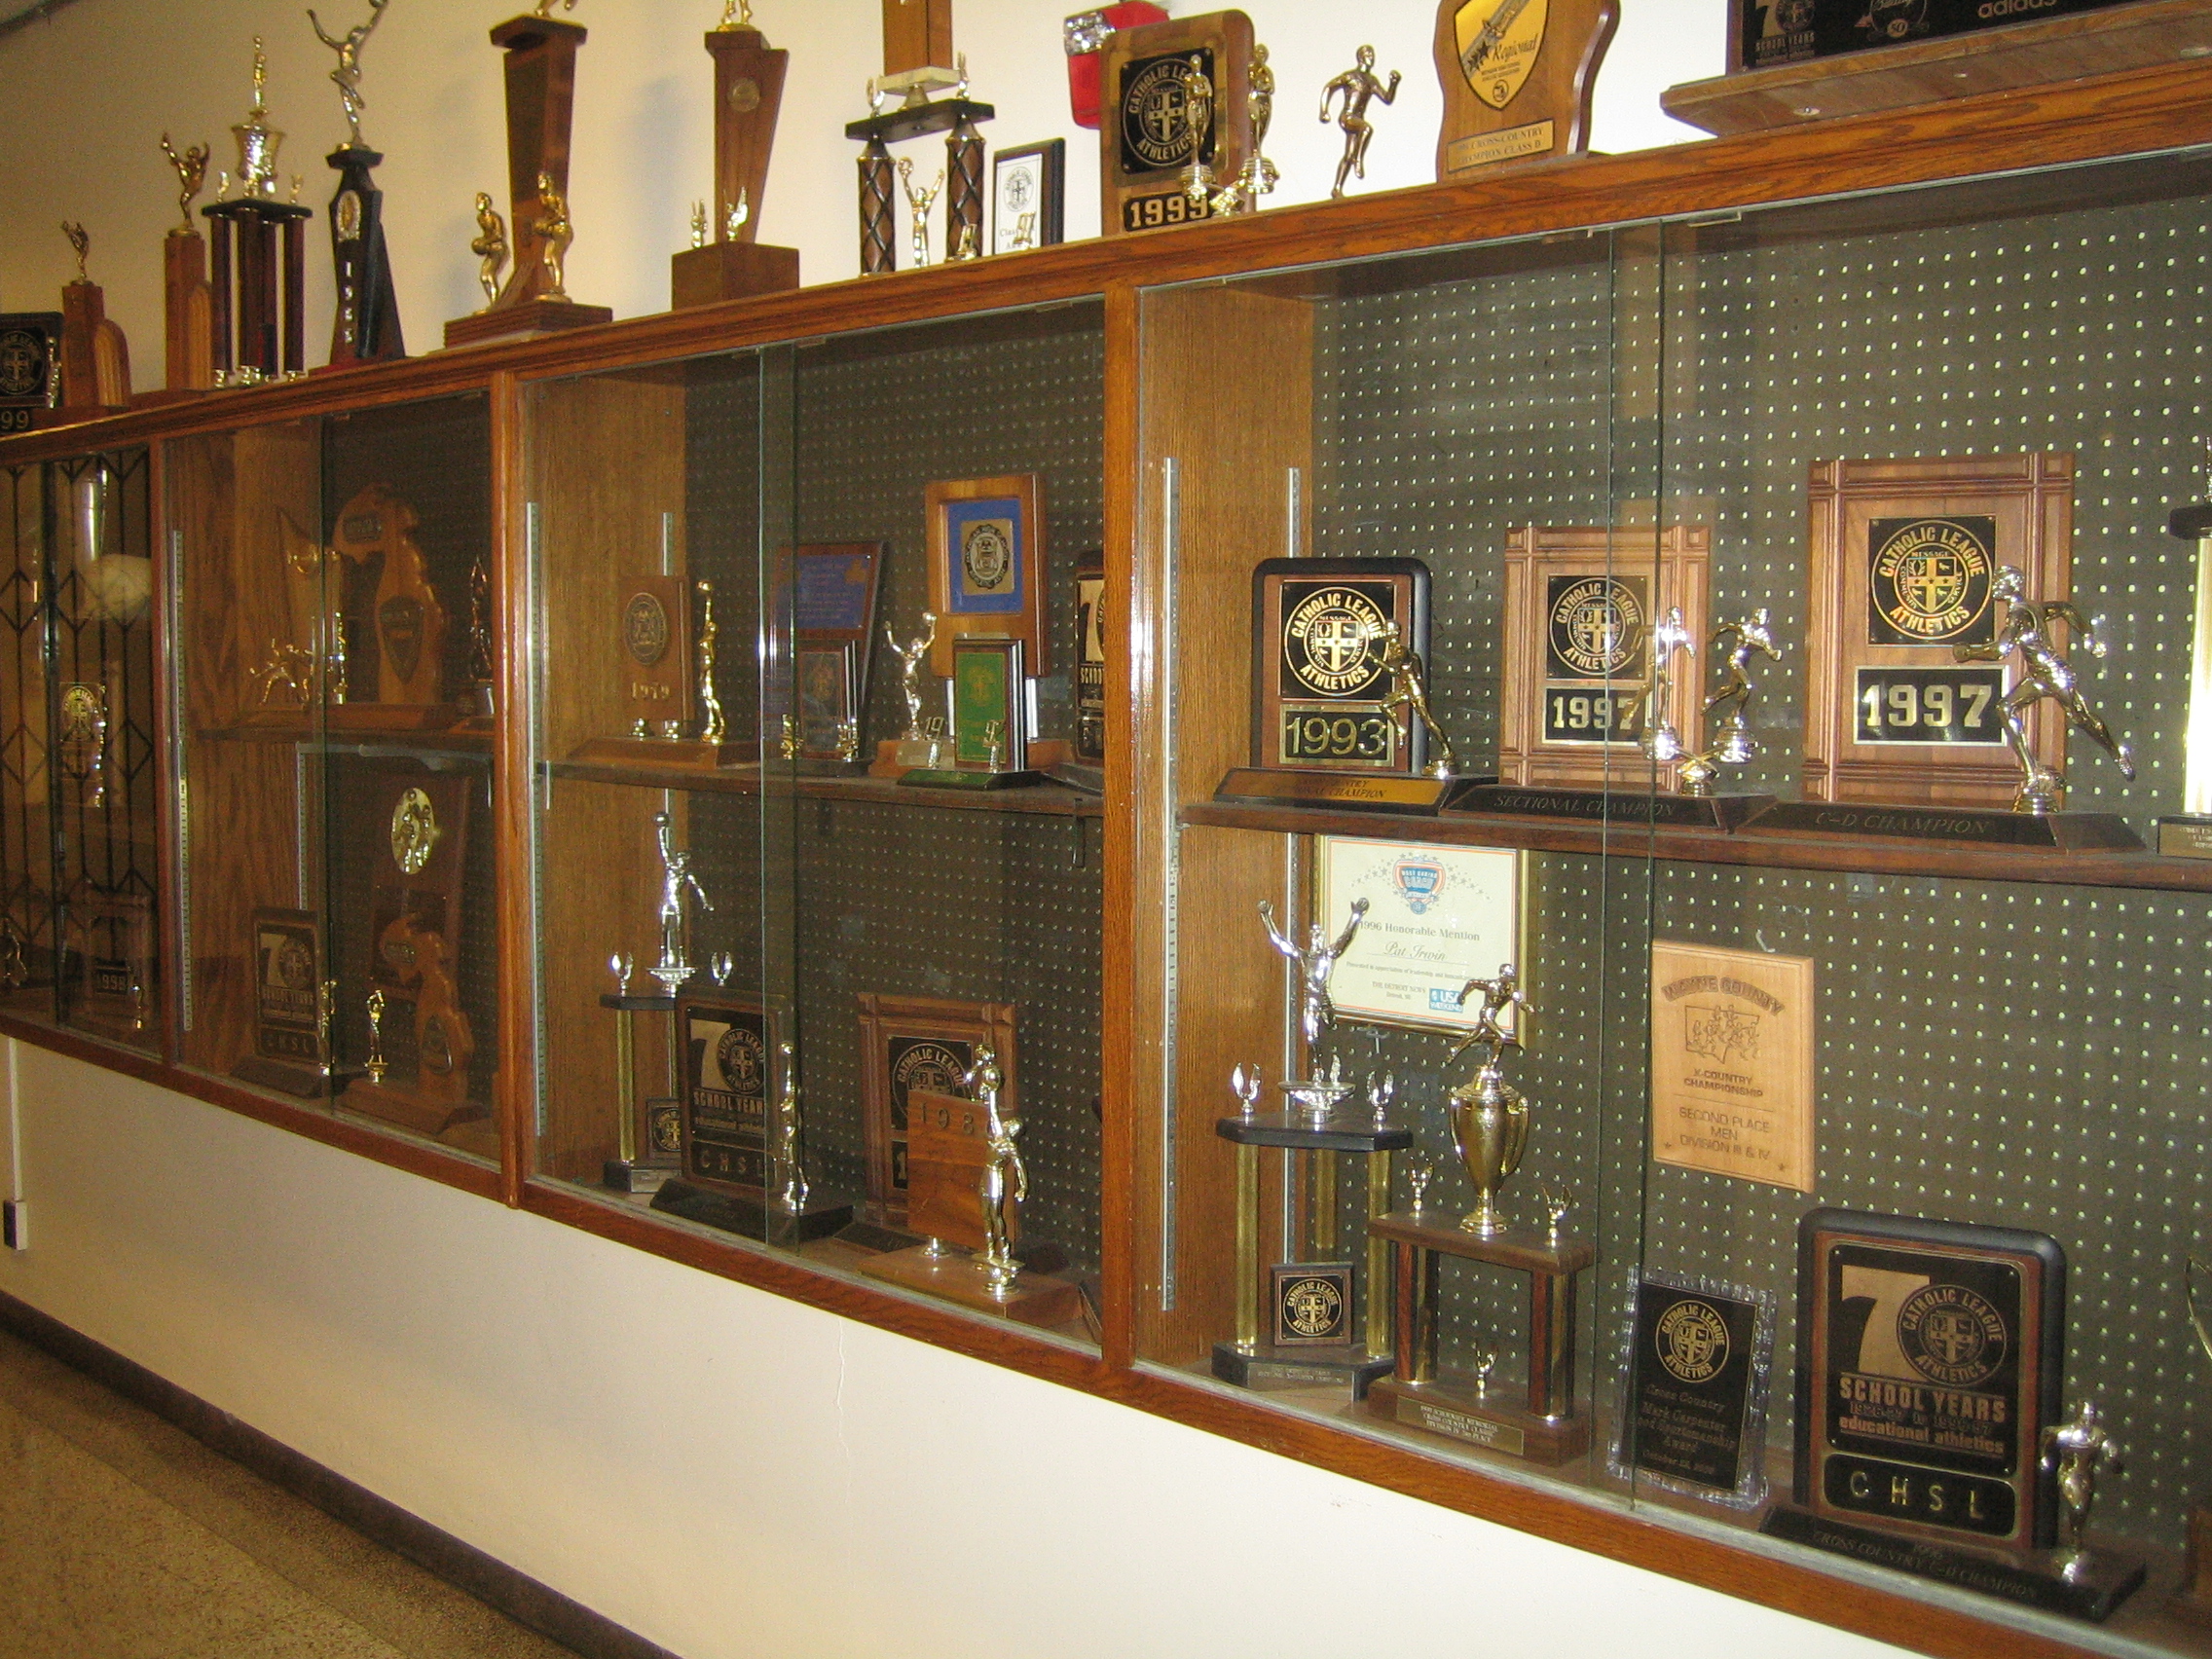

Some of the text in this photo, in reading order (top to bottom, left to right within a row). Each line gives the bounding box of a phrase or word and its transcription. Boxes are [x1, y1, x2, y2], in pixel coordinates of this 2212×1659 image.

[1128, 65, 1171, 114] CATHOLIC
[1130, 195, 1208, 229] 1999
[1878, 527, 1985, 577] CATHOLIC LEAGUE
[1291, 593, 1382, 641] CATHOLIC LEAGUE
[1556, 583, 1640, 626] CATHOLIC EAGUE
[1889, 606, 1971, 634] ATHLETICS
[1300, 664, 1370, 690] ATHLETICS
[1553, 696, 1640, 730] 1997
[1862, 684, 1992, 727] 1997
[1286, 716, 1386, 756] 1993
[1493, 794, 1580, 811] SECTIONAL
[1864, 815, 1989, 833] CHAMPION
[1384, 922, 1437, 938] Honorable
[1439, 928, 1481, 941] Mention
[1382, 940, 1448, 962] Pat Irwin
[1719, 976, 1785, 1015] COUNTY
[897, 1049, 933, 1084] CATHOLIC
[1694, 1068, 1752, 1085] X-COUNTRY
[693, 1090, 764, 1116] SCHOOL YEAR
[1683, 1078, 1763, 1097] CHAMPIONSHIP
[1679, 1107, 1770, 1133] SECOND PLACE
[1711, 1126, 1738, 1141] MEN
[1680, 1134, 1730, 1153] DIVISION
[1662, 1305, 1699, 1335] CATHOLIC
[1701, 1309, 1725, 1346] LEAGUE
[1902, 1288, 1957, 1331] CATHOLIC
[1961, 1292, 2004, 1342] LEAGUE
[1664, 1354, 1714, 1378] ATHLETICS
[1915, 1354, 1987, 1382] ATHLETICS
[1839, 1377, 2007, 1423] SCHOOL YEARS
[1839, 1416, 2005, 1455] educational athletics
